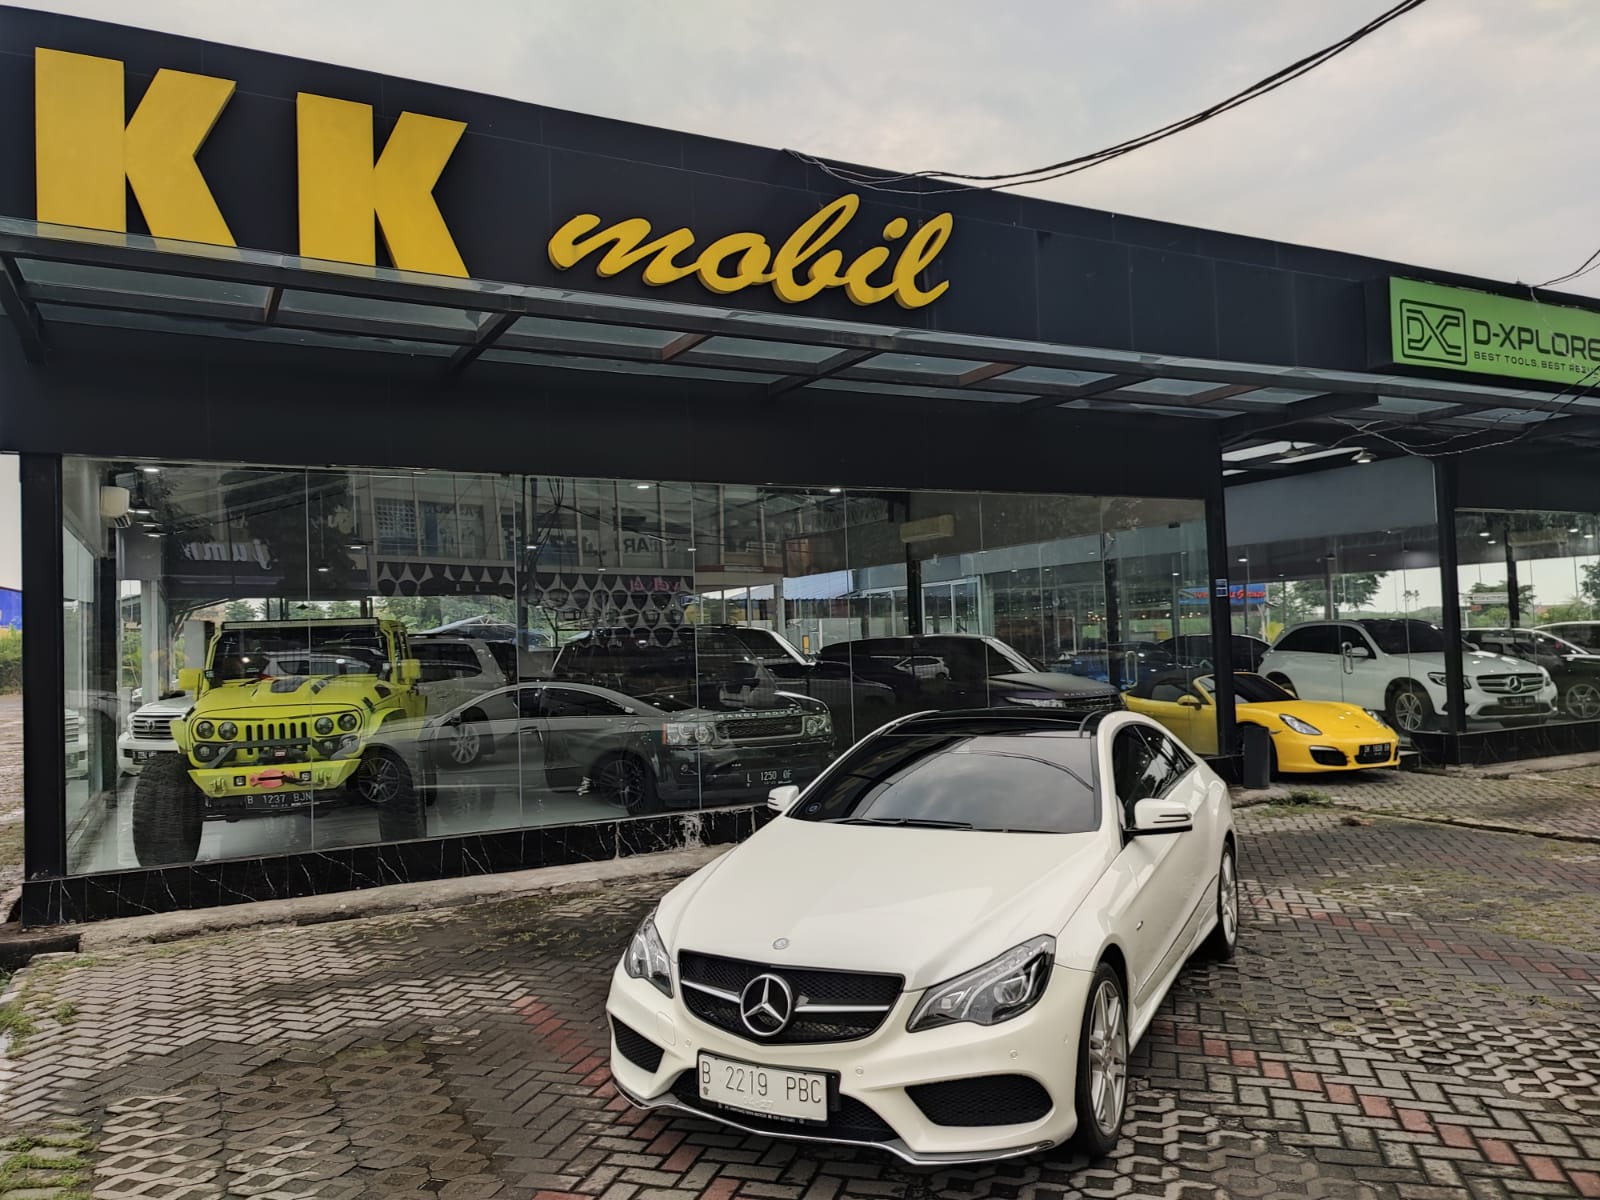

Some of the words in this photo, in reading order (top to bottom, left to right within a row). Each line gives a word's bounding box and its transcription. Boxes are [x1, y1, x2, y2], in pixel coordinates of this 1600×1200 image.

[548, 193, 954, 309] mobil
[1473, 351, 1501, 362] BEST
[1541, 360, 1566, 372] BEST
[746, 772, 753, 783] L
[760, 770, 777, 781] 1250
[247, 795, 254, 805] B
[263, 794, 286, 804] 1237
[701, 1061, 711, 1084] B
[725, 1065, 768, 1096] 2219
[786, 1075, 822, 1104] PBC
